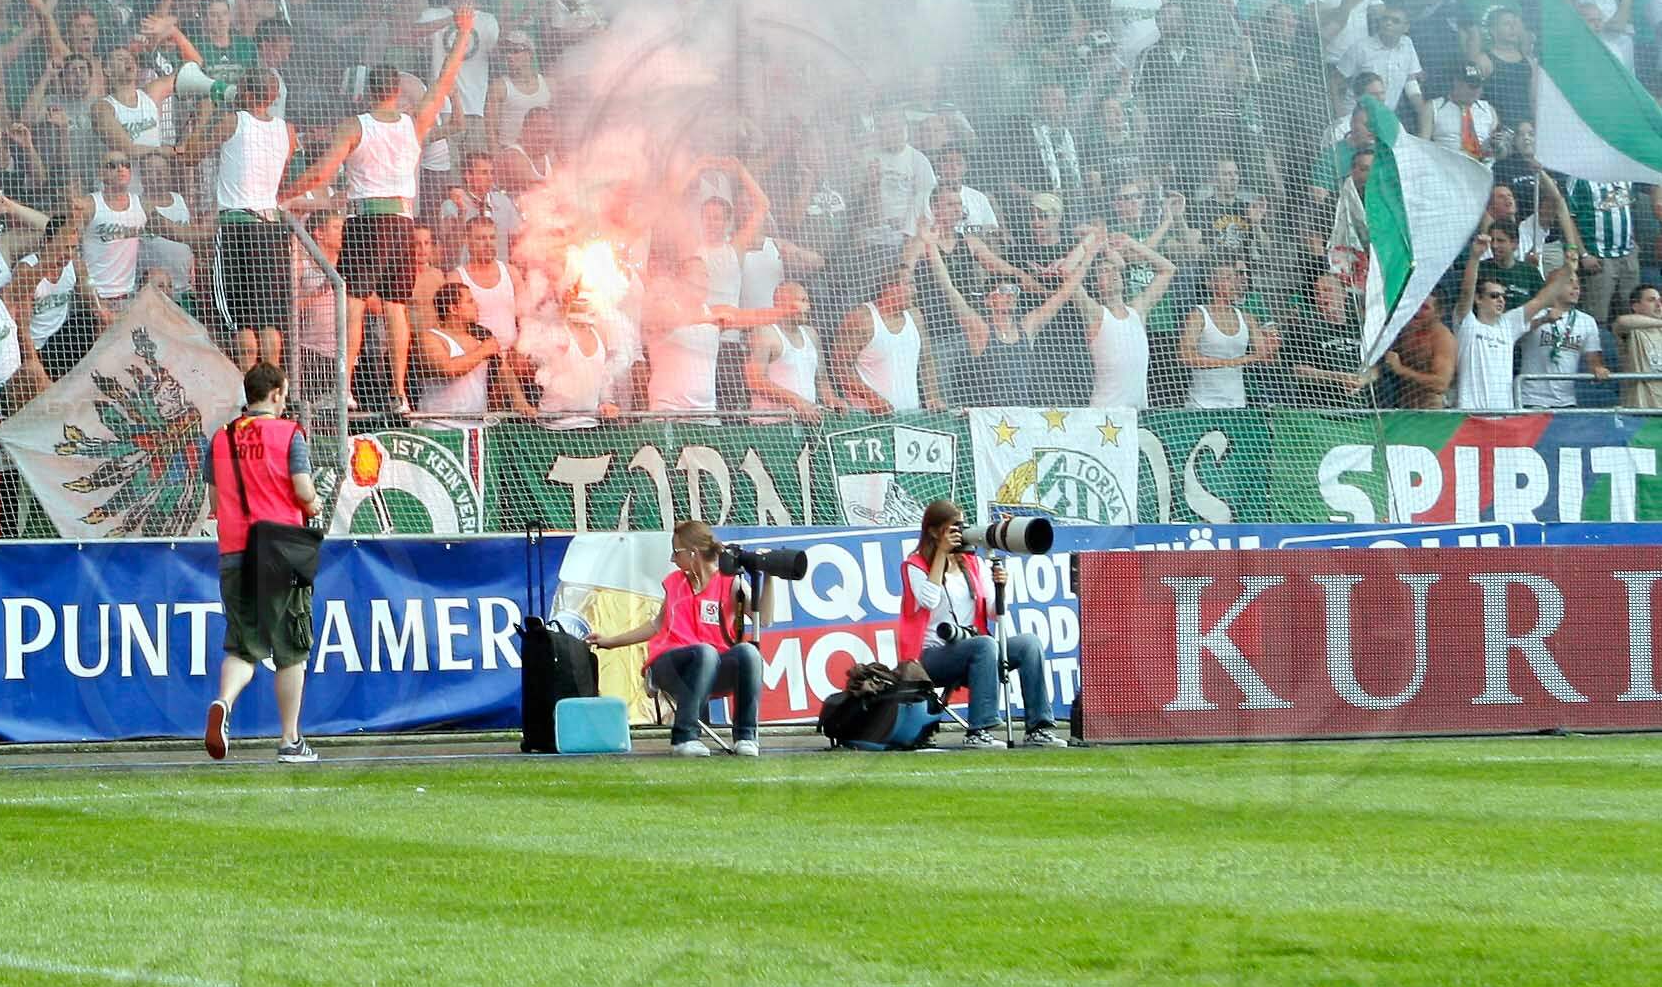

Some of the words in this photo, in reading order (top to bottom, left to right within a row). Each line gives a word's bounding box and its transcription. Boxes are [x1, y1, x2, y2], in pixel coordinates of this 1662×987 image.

[392, 438, 424, 458] IST
[427, 452, 462, 491] KEIN
[844, 439, 885, 464] TR
[906, 438, 941, 466] 96
